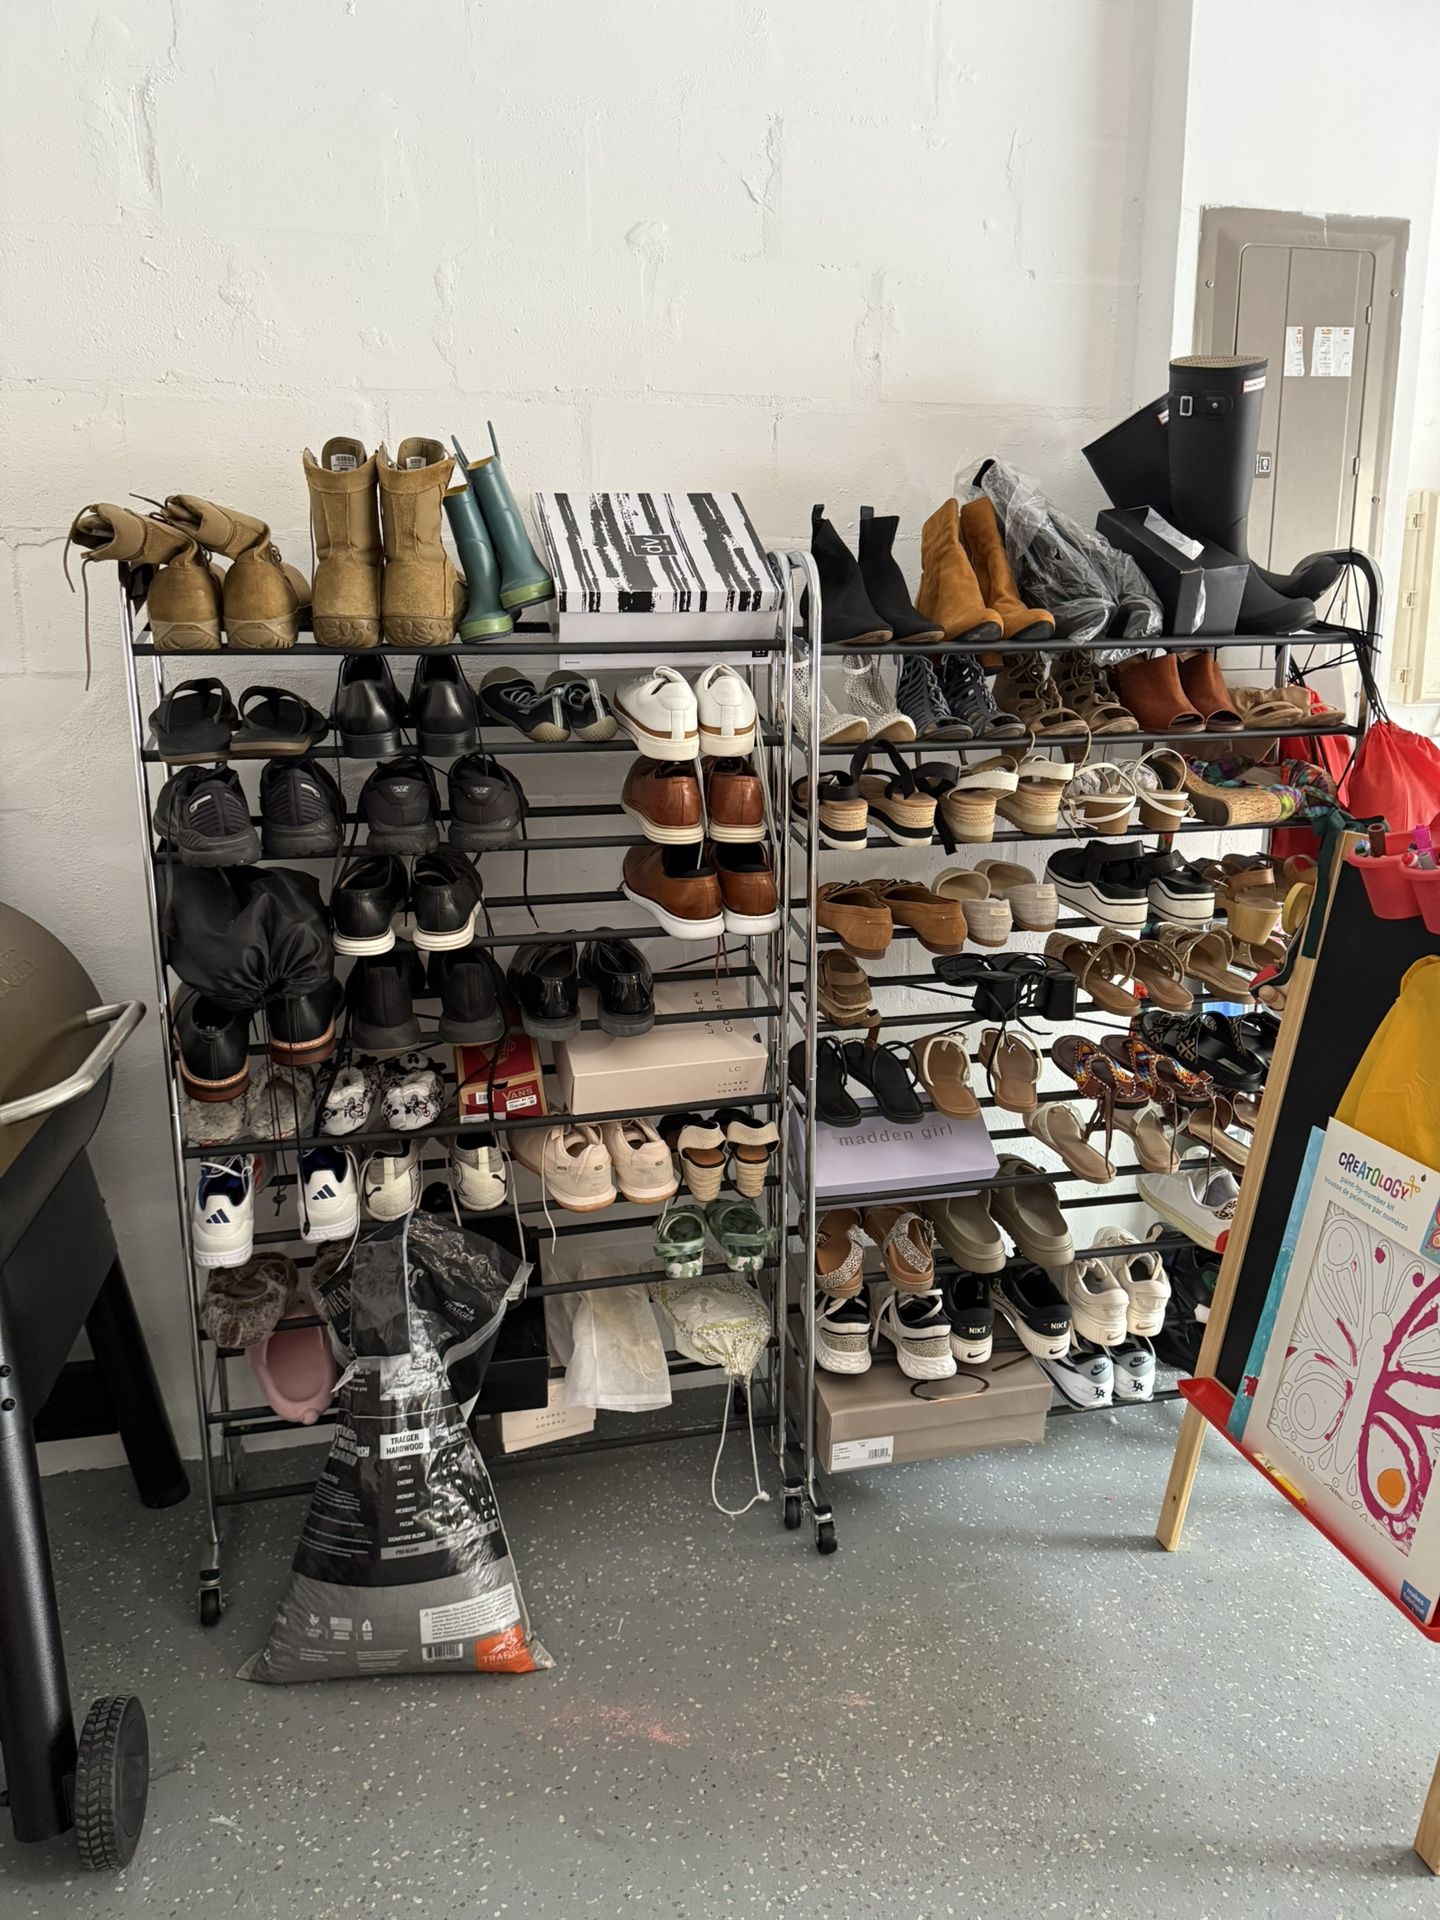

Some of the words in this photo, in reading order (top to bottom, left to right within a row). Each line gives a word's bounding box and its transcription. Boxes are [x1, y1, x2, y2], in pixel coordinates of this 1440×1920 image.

[641, 537, 663, 554] dv
[693, 991, 714, 1035] LAREN
[711, 990, 733, 1033] CORAD
[502, 1085, 533, 1100] VANS
[839, 1130, 914, 1146] madden
[921, 1123, 953, 1140] girl
[1338, 1152, 1409, 1200] CREATOLOGY
[1340, 1176, 1387, 1207] paint-by-number
[1386, 1201, 1395, 1212] kit
[1324, 1176, 1342, 1192] trousse
[1342, 1188, 1349, 1196] de
[1348, 1192, 1372, 1210] peinture
[1372, 1206, 1382, 1216] par
[1382, 1212, 1409, 1232] numéros
[443, 1300, 476, 1323] TRAEGER
[969, 1326, 986, 1334] NIKE
[1051, 1321, 1068, 1330] NIKE
[1093, 1386, 1106, 1399] LA
[1132, 1379, 1145, 1392] LA
[391, 1433, 419, 1445] TRAEGER
[386, 1442, 424, 1455] HARDWOOD
[412, 1532, 426, 1540] BLEND
